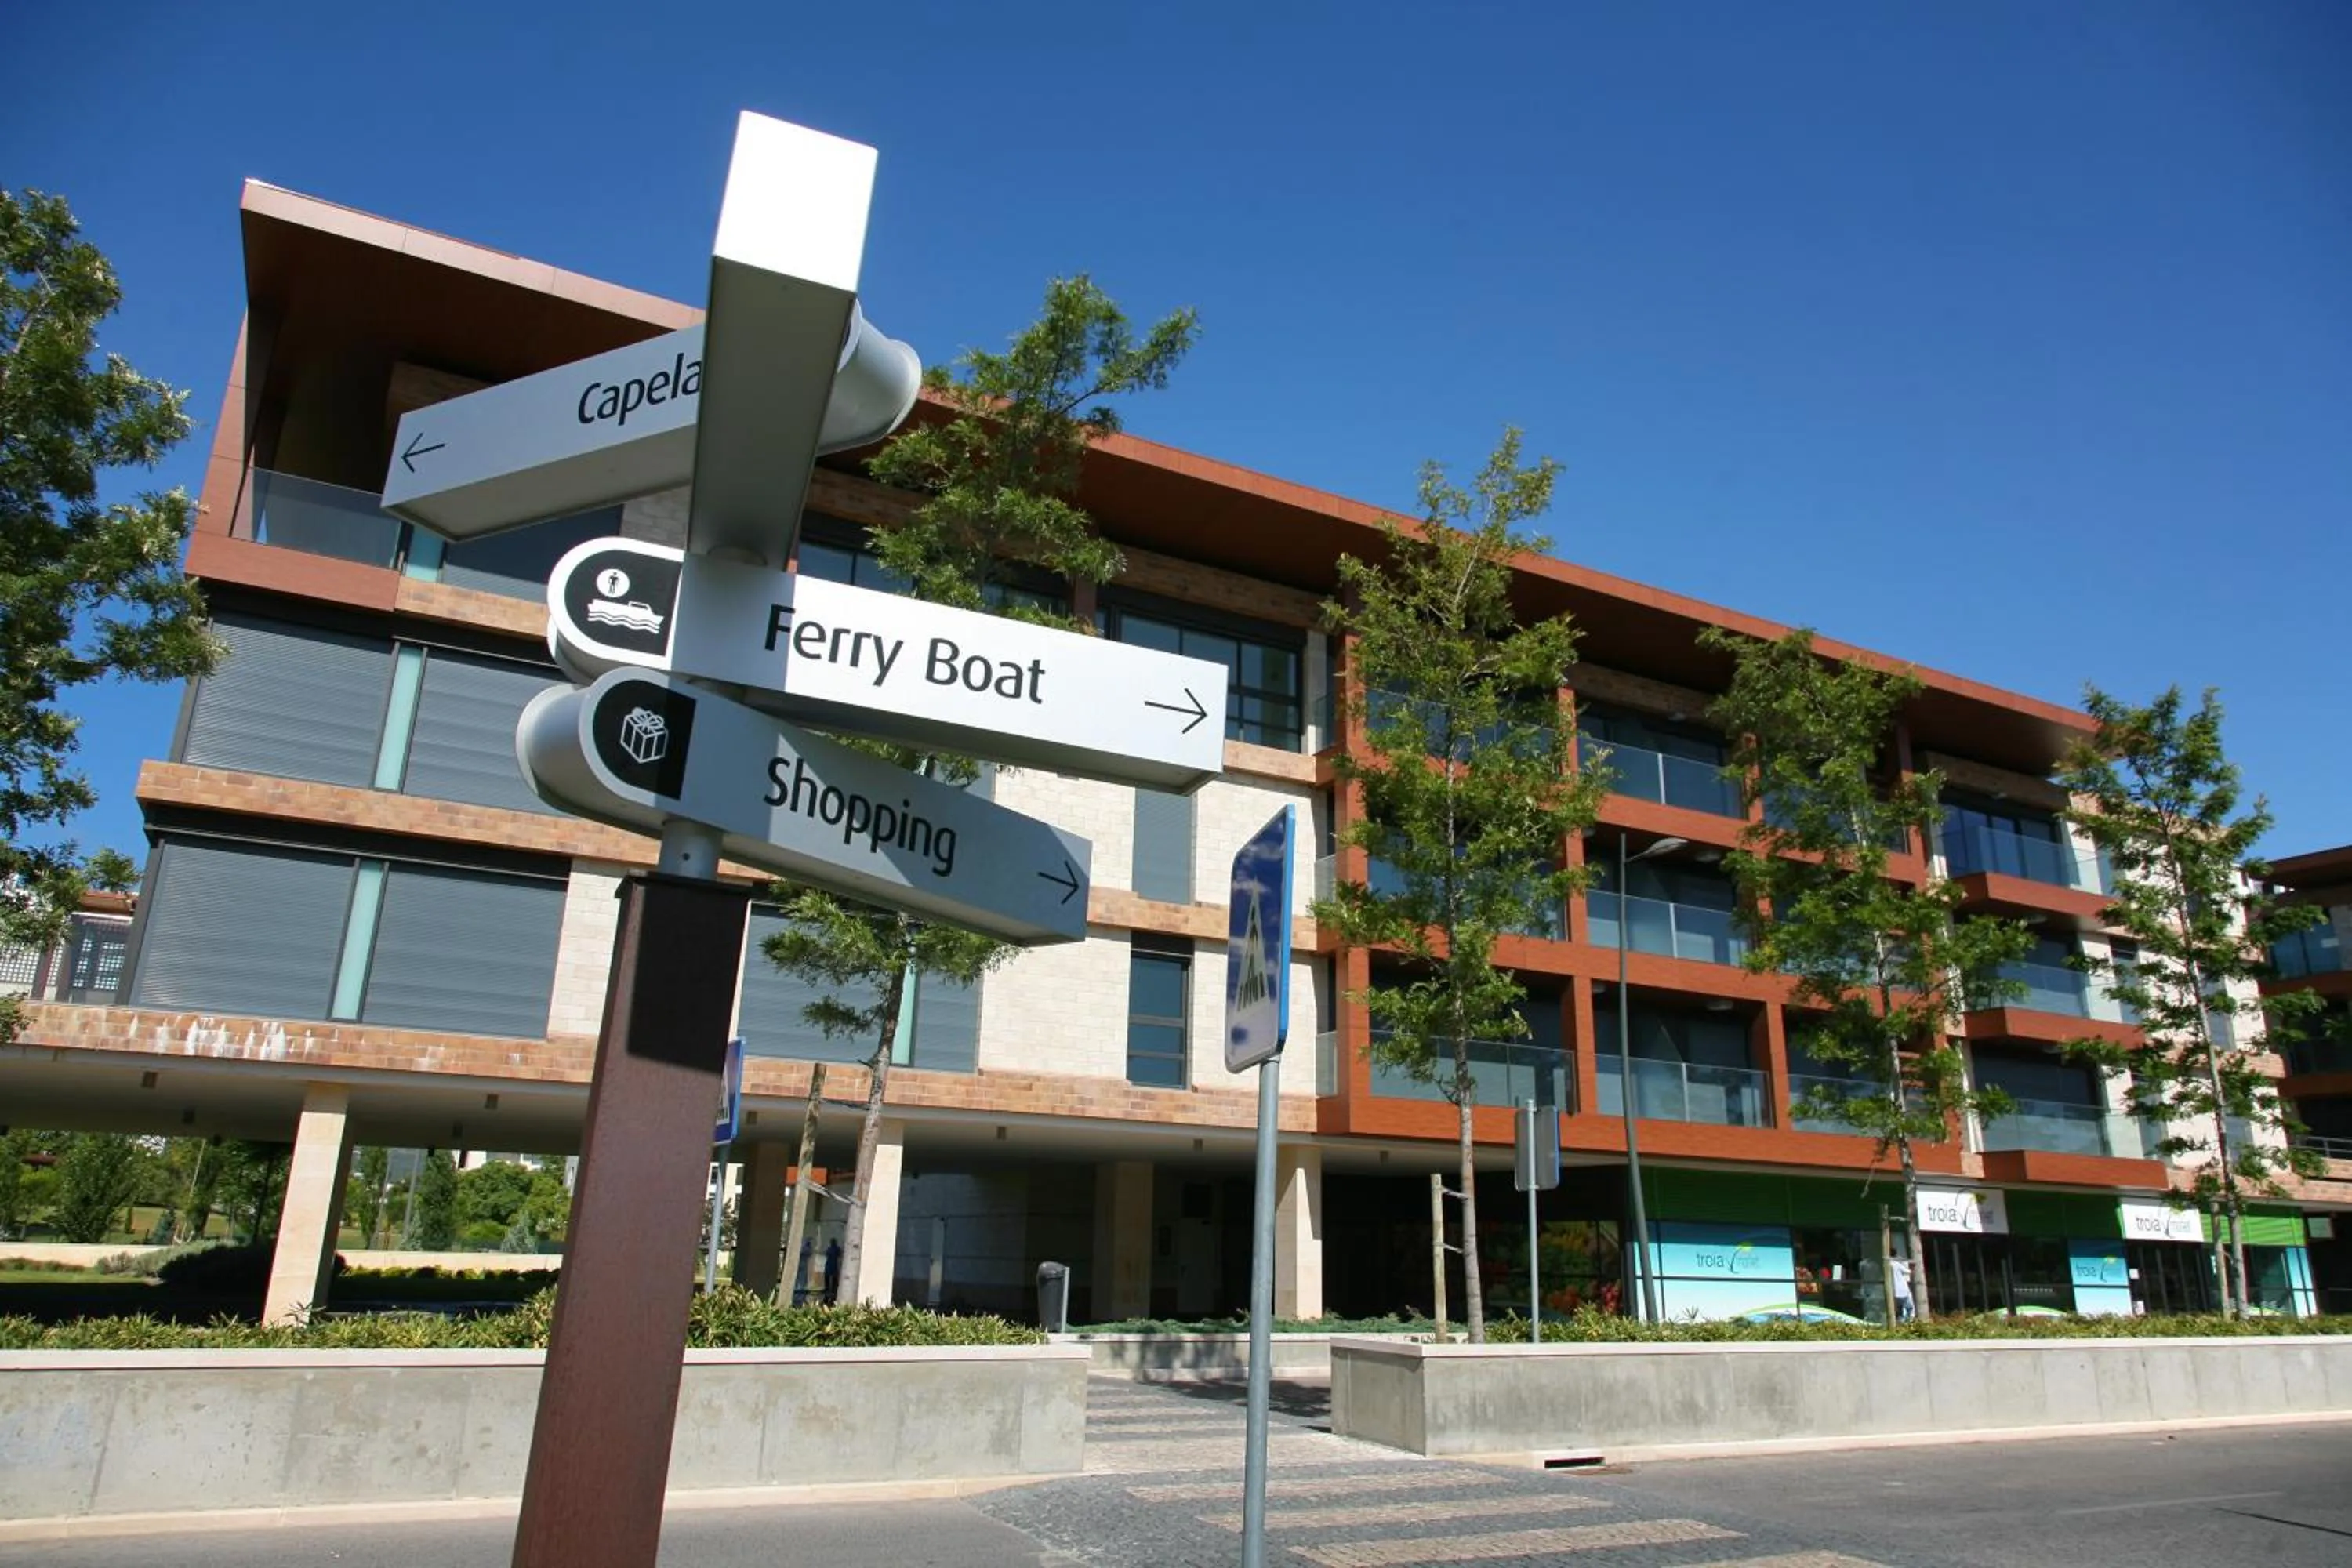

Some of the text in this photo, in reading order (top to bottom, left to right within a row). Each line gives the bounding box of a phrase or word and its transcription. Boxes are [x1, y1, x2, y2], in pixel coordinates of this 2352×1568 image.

[764, 603, 1046, 704] Ferry Boat
[763, 755, 957, 877] Shopping
